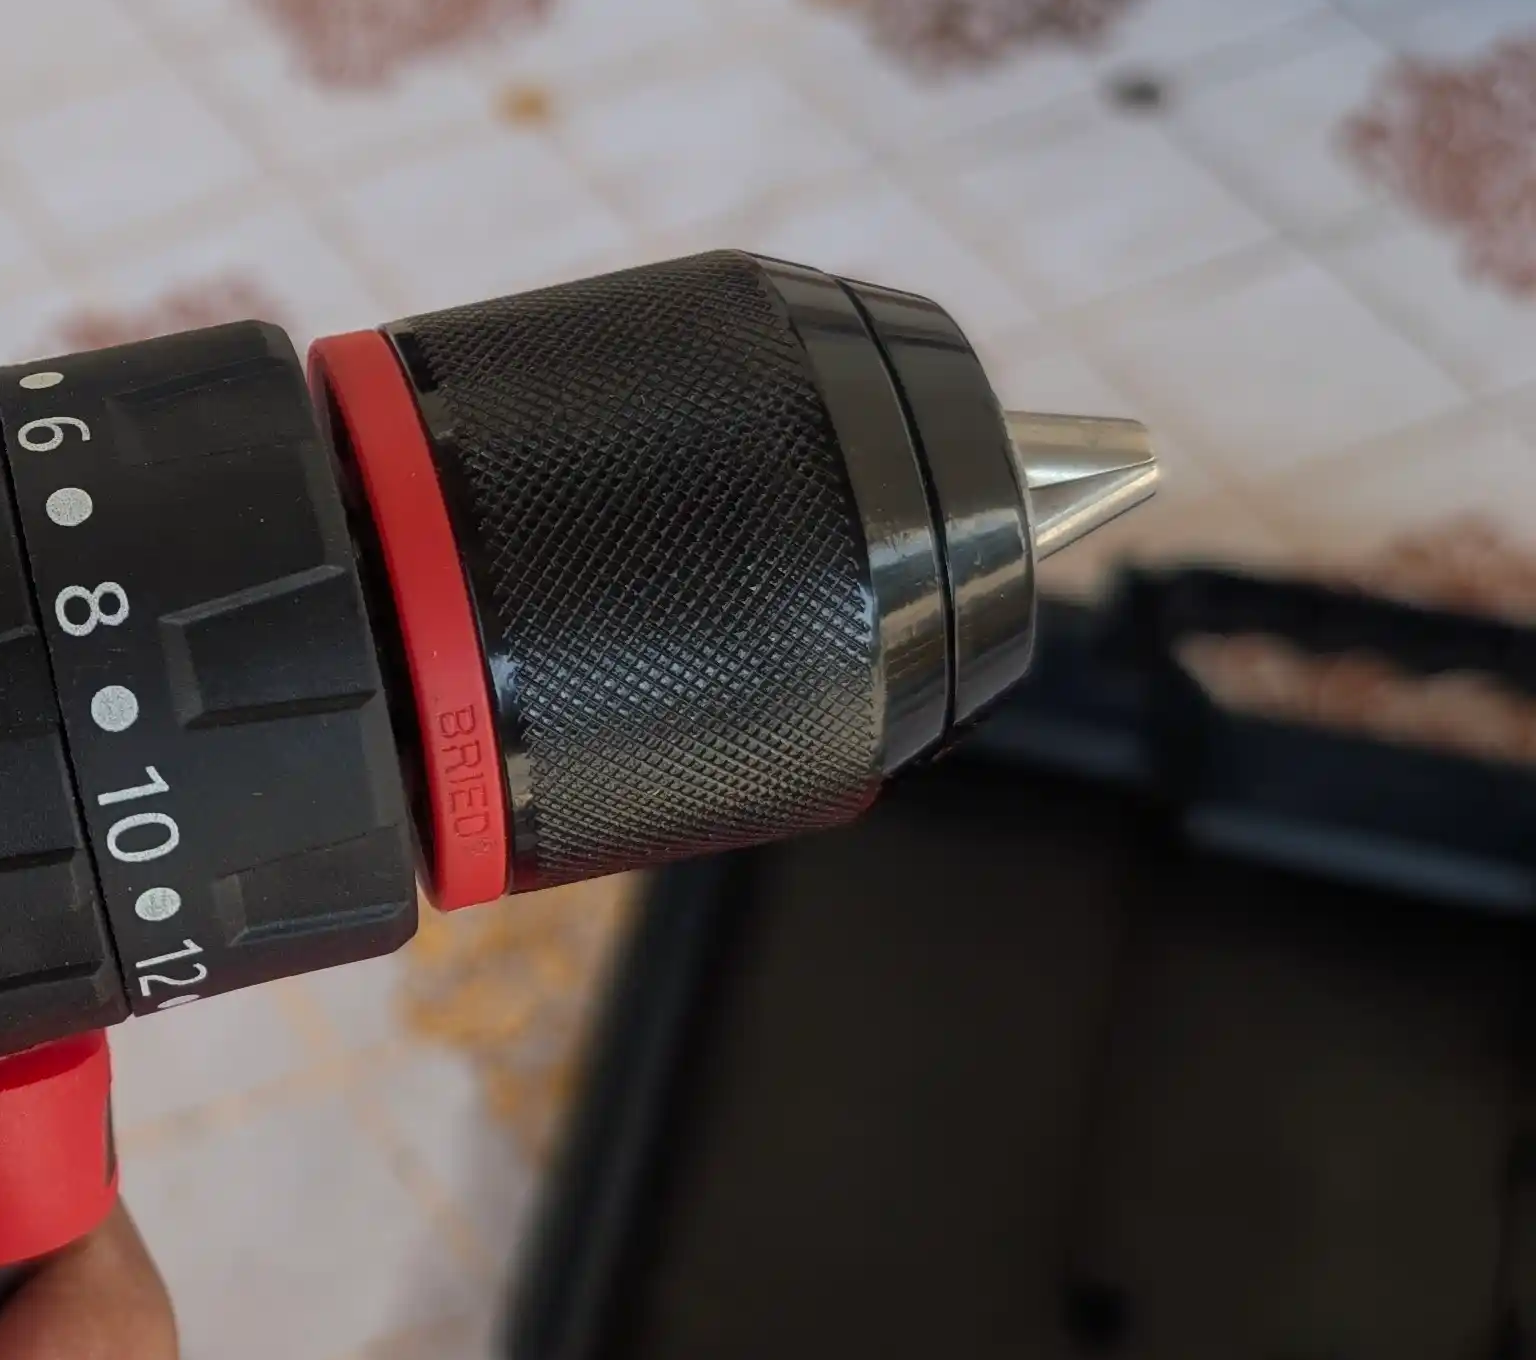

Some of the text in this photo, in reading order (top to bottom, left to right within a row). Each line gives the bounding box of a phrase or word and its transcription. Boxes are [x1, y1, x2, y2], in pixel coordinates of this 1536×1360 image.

[17, 416, 208, 997] 6 8 10 12
